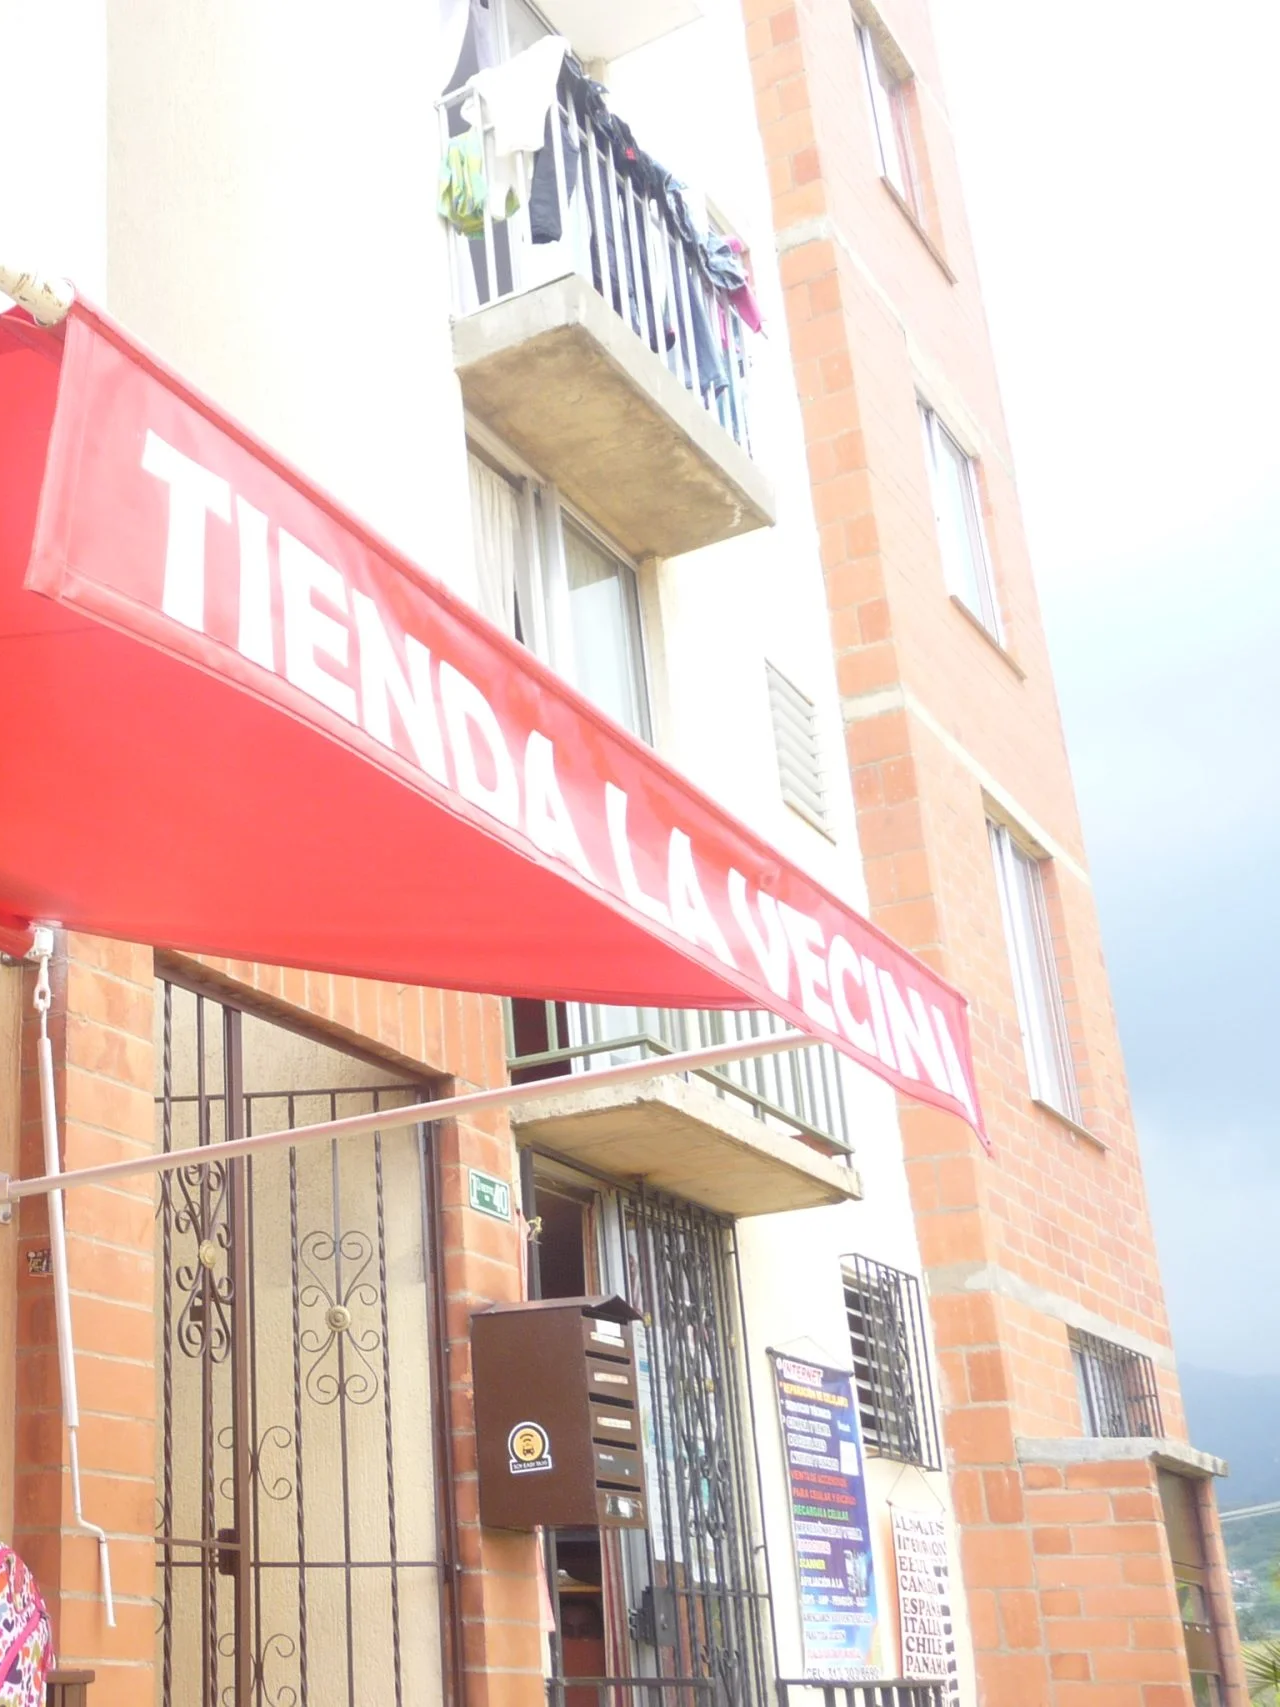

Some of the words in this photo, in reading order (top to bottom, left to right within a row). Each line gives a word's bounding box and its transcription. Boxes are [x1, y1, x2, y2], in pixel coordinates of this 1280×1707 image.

[141, 430, 604, 890] TIENDA
[605, 781, 740, 971] LA
[904, 1616, 942, 1636] ITALIA
[906, 1636, 943, 1655] CHILE
